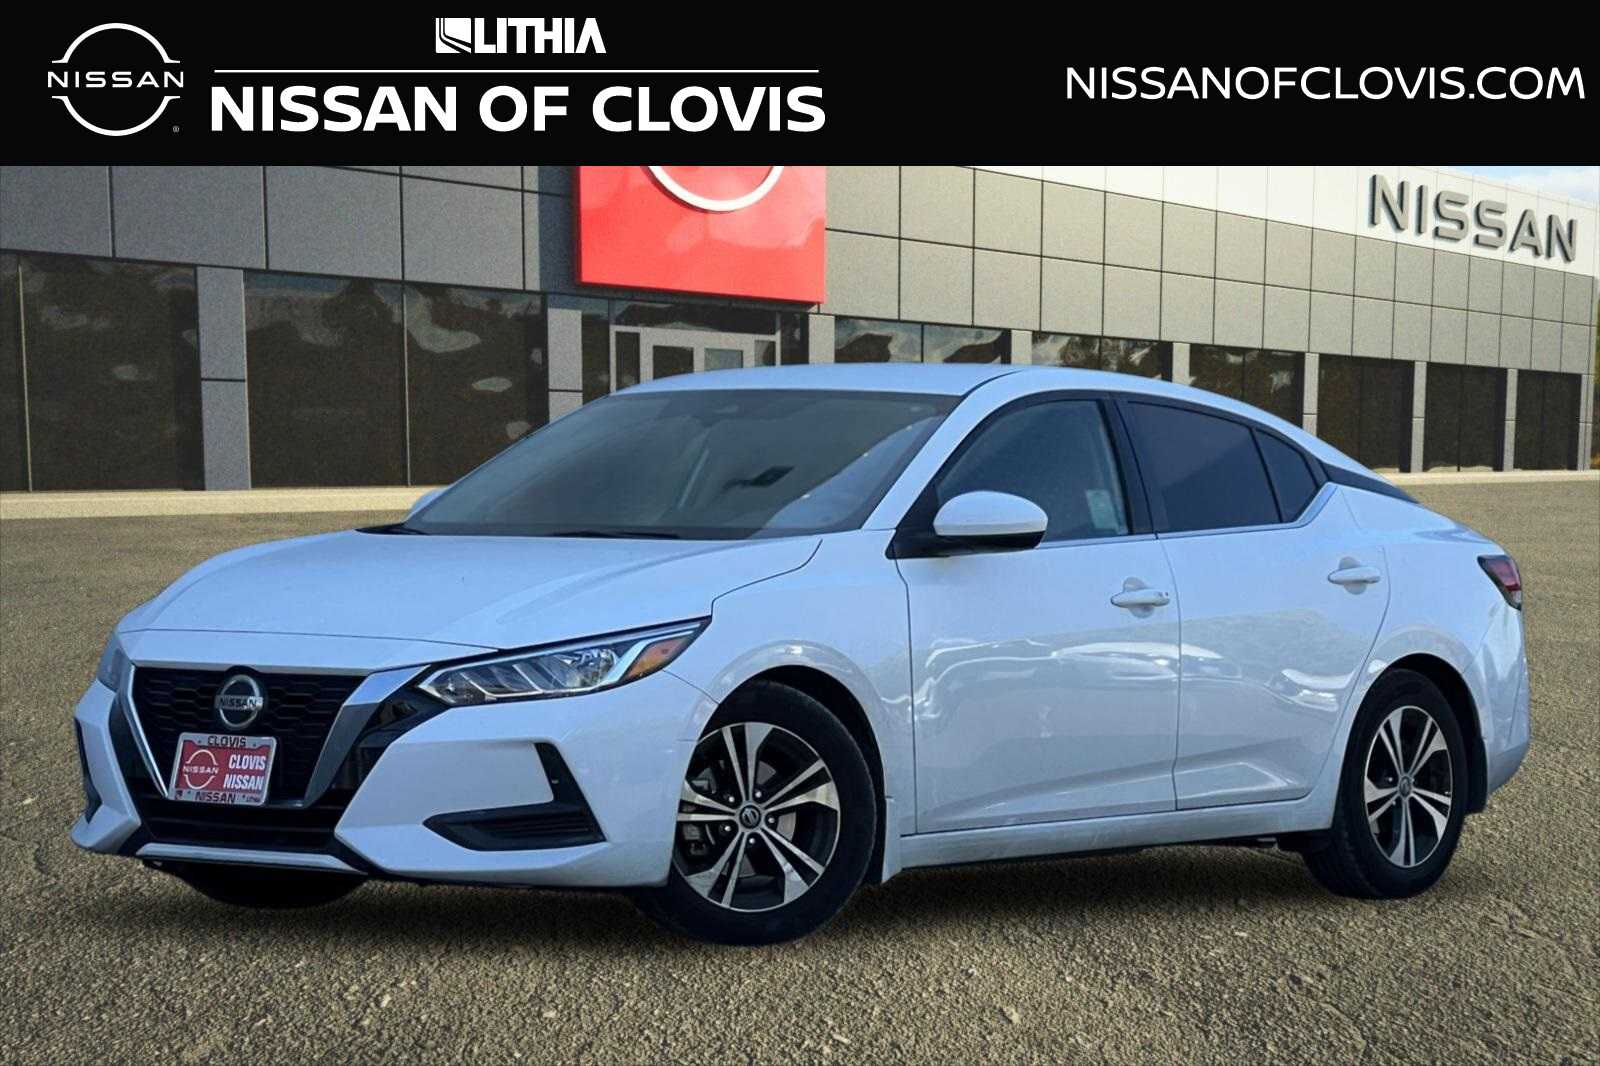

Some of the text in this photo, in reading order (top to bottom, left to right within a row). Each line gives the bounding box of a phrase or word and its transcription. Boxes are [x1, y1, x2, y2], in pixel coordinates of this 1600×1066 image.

[1369, 174, 1578, 262] NISSAN
[219, 697, 257, 707] NISSAN
[207, 735, 246, 747] CLOVIS
[183, 765, 218, 774] NISSAN
[228, 755, 266, 770] CLOVIS
[223, 774, 264, 790] NISSAN
[195, 790, 236, 804] NISSAN
